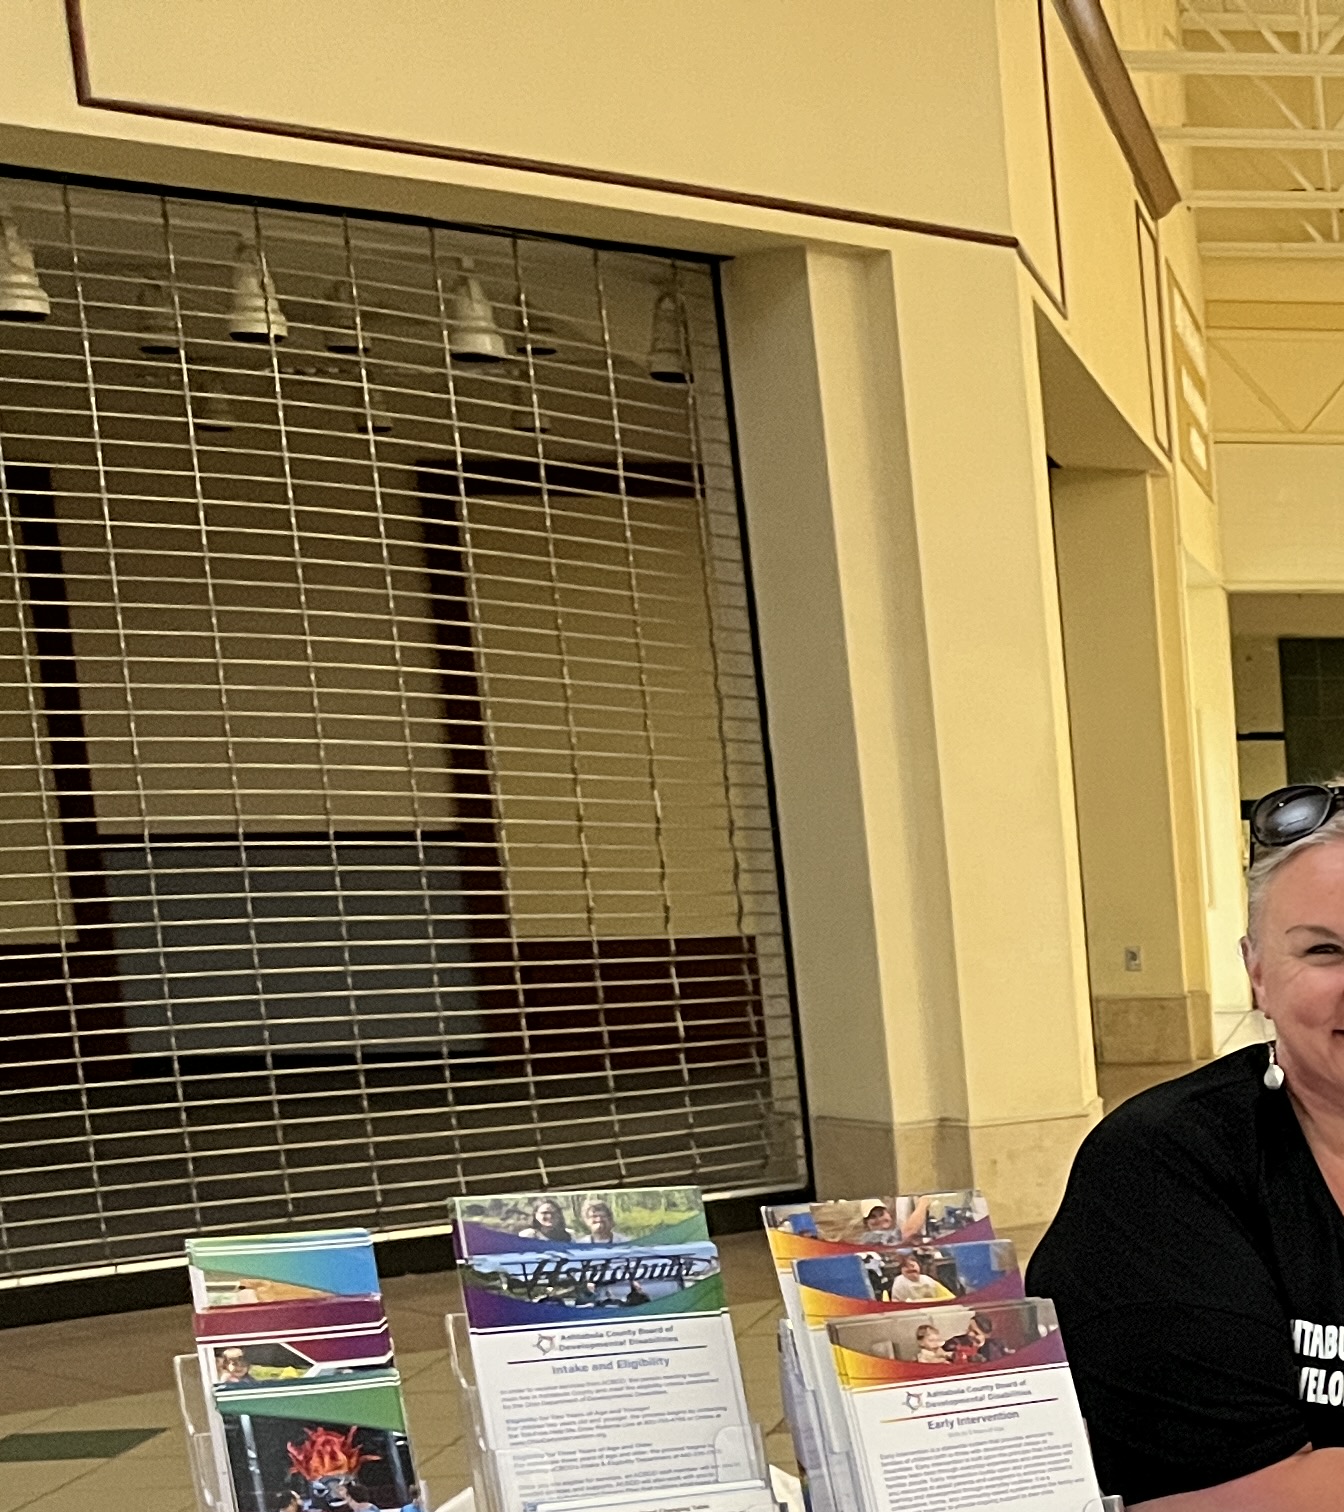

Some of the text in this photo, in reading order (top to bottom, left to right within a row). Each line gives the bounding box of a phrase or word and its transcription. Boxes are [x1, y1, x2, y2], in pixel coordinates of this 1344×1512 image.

[551, 1355, 671, 1375] Intake and Eligibility
[927, 1410, 1020, 1431] Early Intervention
